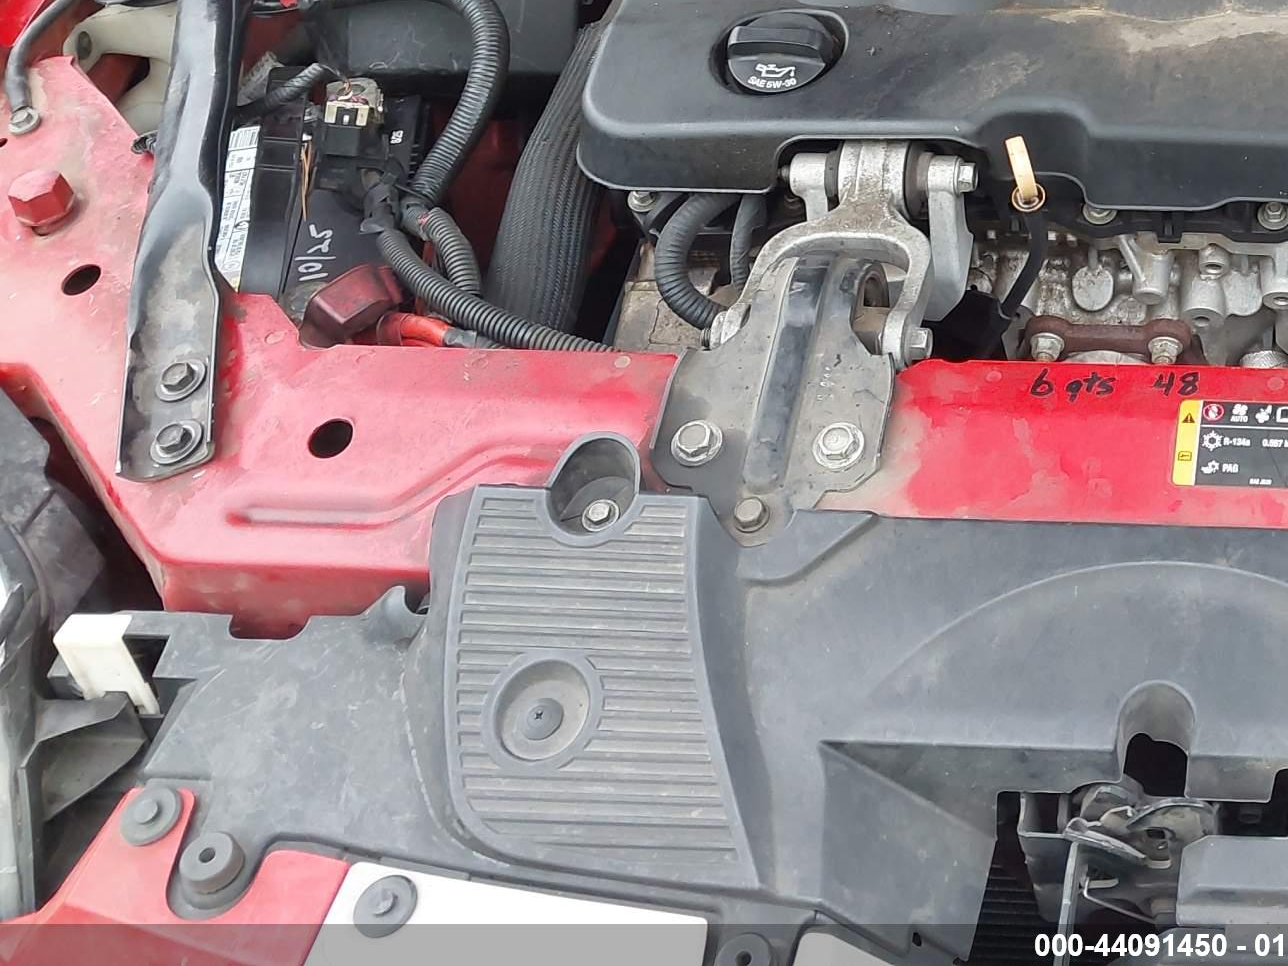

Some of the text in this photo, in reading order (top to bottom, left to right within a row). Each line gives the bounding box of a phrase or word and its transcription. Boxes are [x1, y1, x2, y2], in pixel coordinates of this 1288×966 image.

[748, 76, 797, 89] SAE 5W-30
[1030, 368, 1054, 397] 6
[1152, 370, 1200, 396] 48
